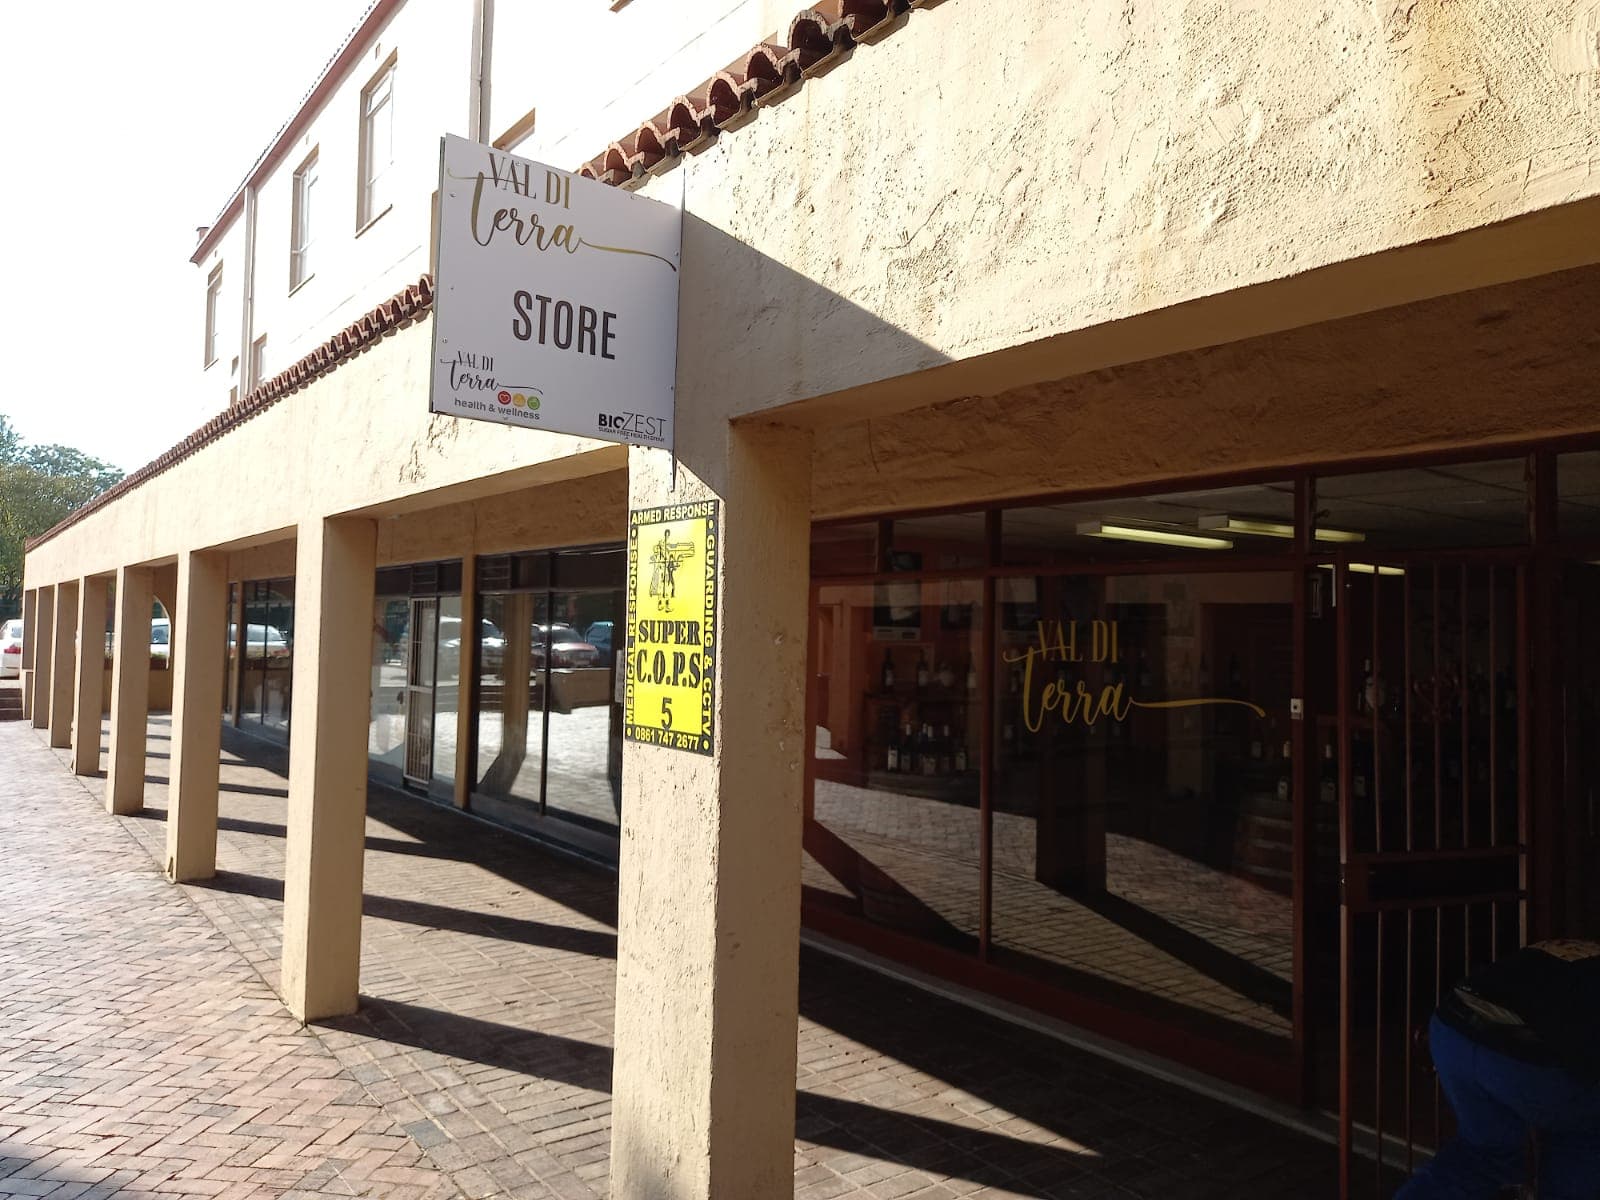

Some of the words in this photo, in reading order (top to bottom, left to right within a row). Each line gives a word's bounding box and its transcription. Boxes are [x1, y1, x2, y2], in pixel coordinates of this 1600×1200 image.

[489, 153, 536, 199] VAL
[545, 170, 570, 209] DI
[512, 290, 617, 360] STORE
[482, 355, 493, 371] DI
[454, 397, 486, 411] health
[488, 404, 496, 412] &
[497, 405, 540, 420] wellness
[631, 510, 662, 525] ARMED
[663, 501, 715, 521] RESPONSE
[628, 539, 638, 635] RESPONSE
[704, 534, 715, 648] GUARDING
[638, 620, 701, 645] SUPER
[1037, 620, 1083, 662] VAL
[1090, 620, 1119, 663] DI
[626, 640, 635, 724] MEDICAL
[636, 649, 701, 688] C.O.P.S
[704, 655, 713, 670] &
[661, 697, 673, 730] 5
[702, 677, 713, 736] CCTV
[635, 727, 655, 742] 0861
[657, 730, 674, 747] 747
[676, 733, 699, 750] 2677
